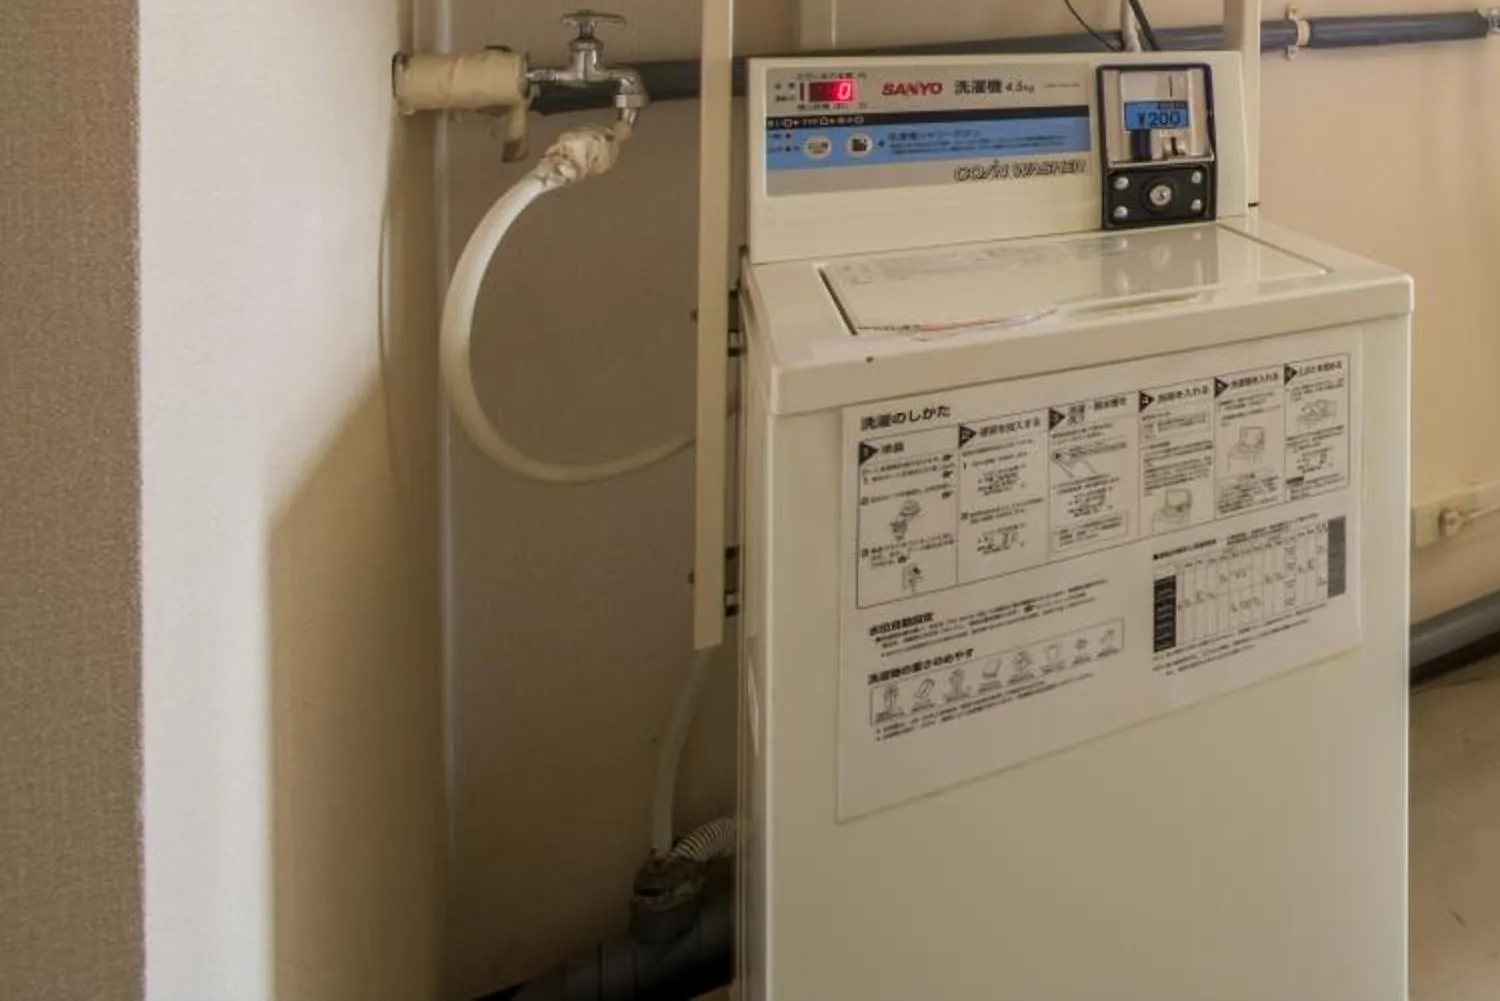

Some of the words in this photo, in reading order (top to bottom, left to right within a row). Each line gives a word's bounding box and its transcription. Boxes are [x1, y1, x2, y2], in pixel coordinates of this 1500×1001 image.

[838, 82, 852, 100] 0
[881, 80, 943, 97] SANYO
[954, 78, 1002, 95] 洗濯機
[860, 405, 952, 430] 洗濯のしかた
